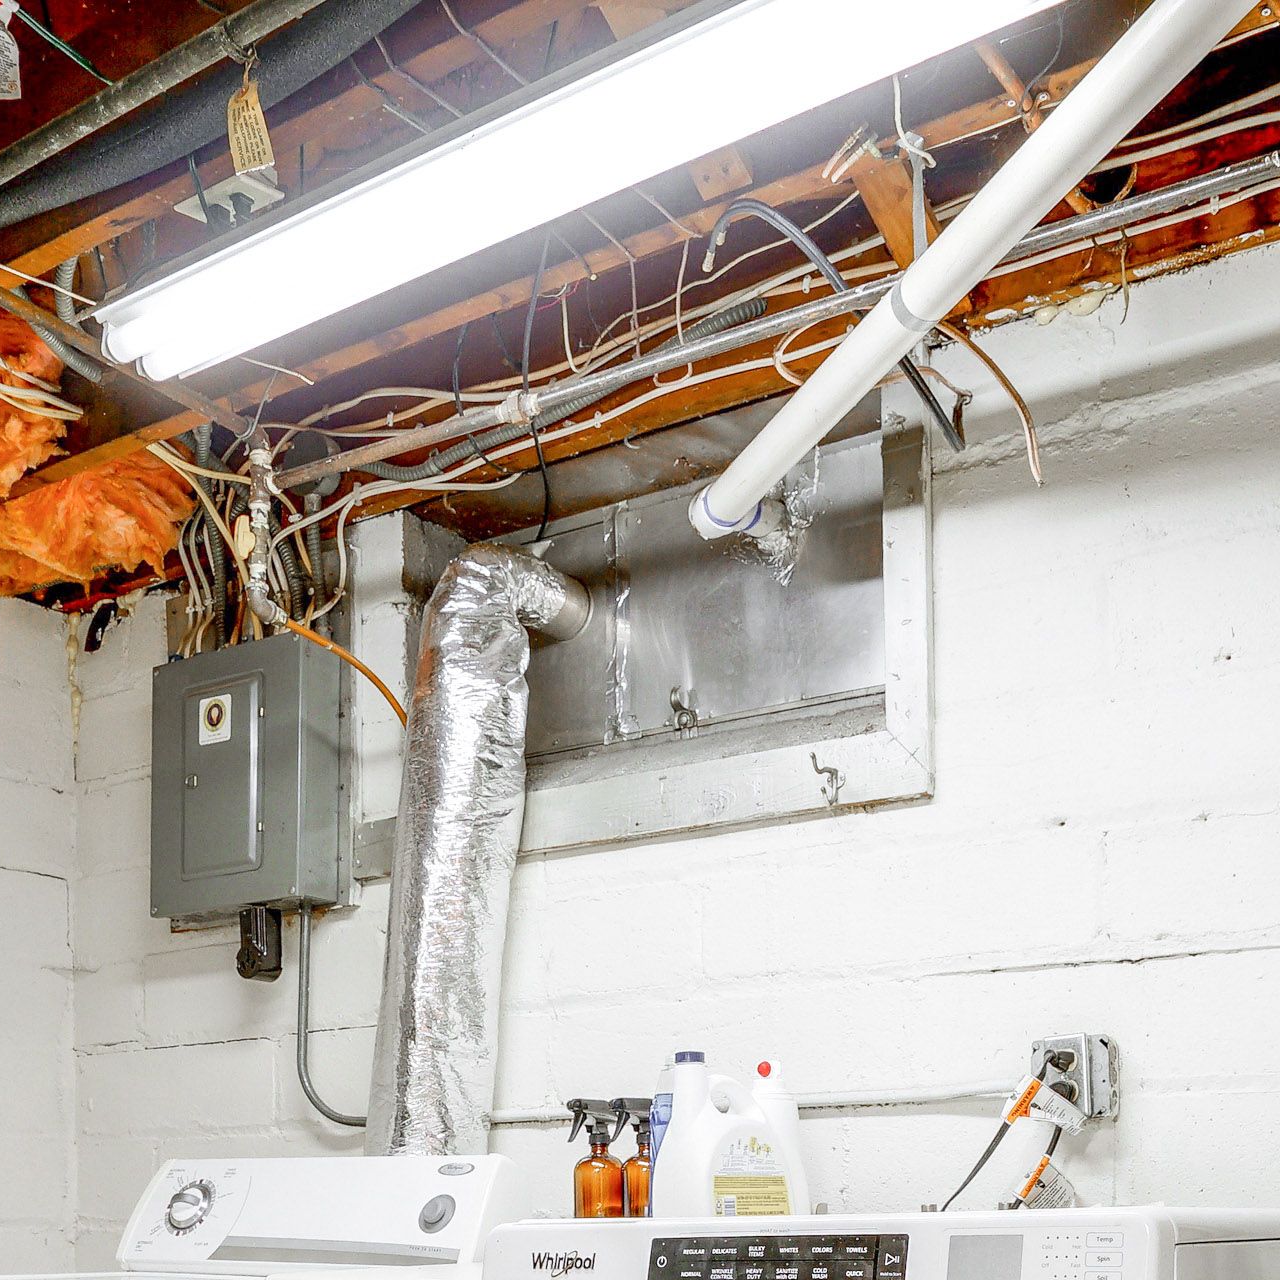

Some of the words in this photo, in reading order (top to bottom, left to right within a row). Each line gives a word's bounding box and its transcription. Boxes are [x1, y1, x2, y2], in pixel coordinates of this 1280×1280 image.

[1011, 1090, 1033, 1117] WARNING
[1096, 1236, 1114, 1244] Temp
[532, 1251, 596, 1276] Whirlpool
[1096, 1255, 1111, 1263] Spin
